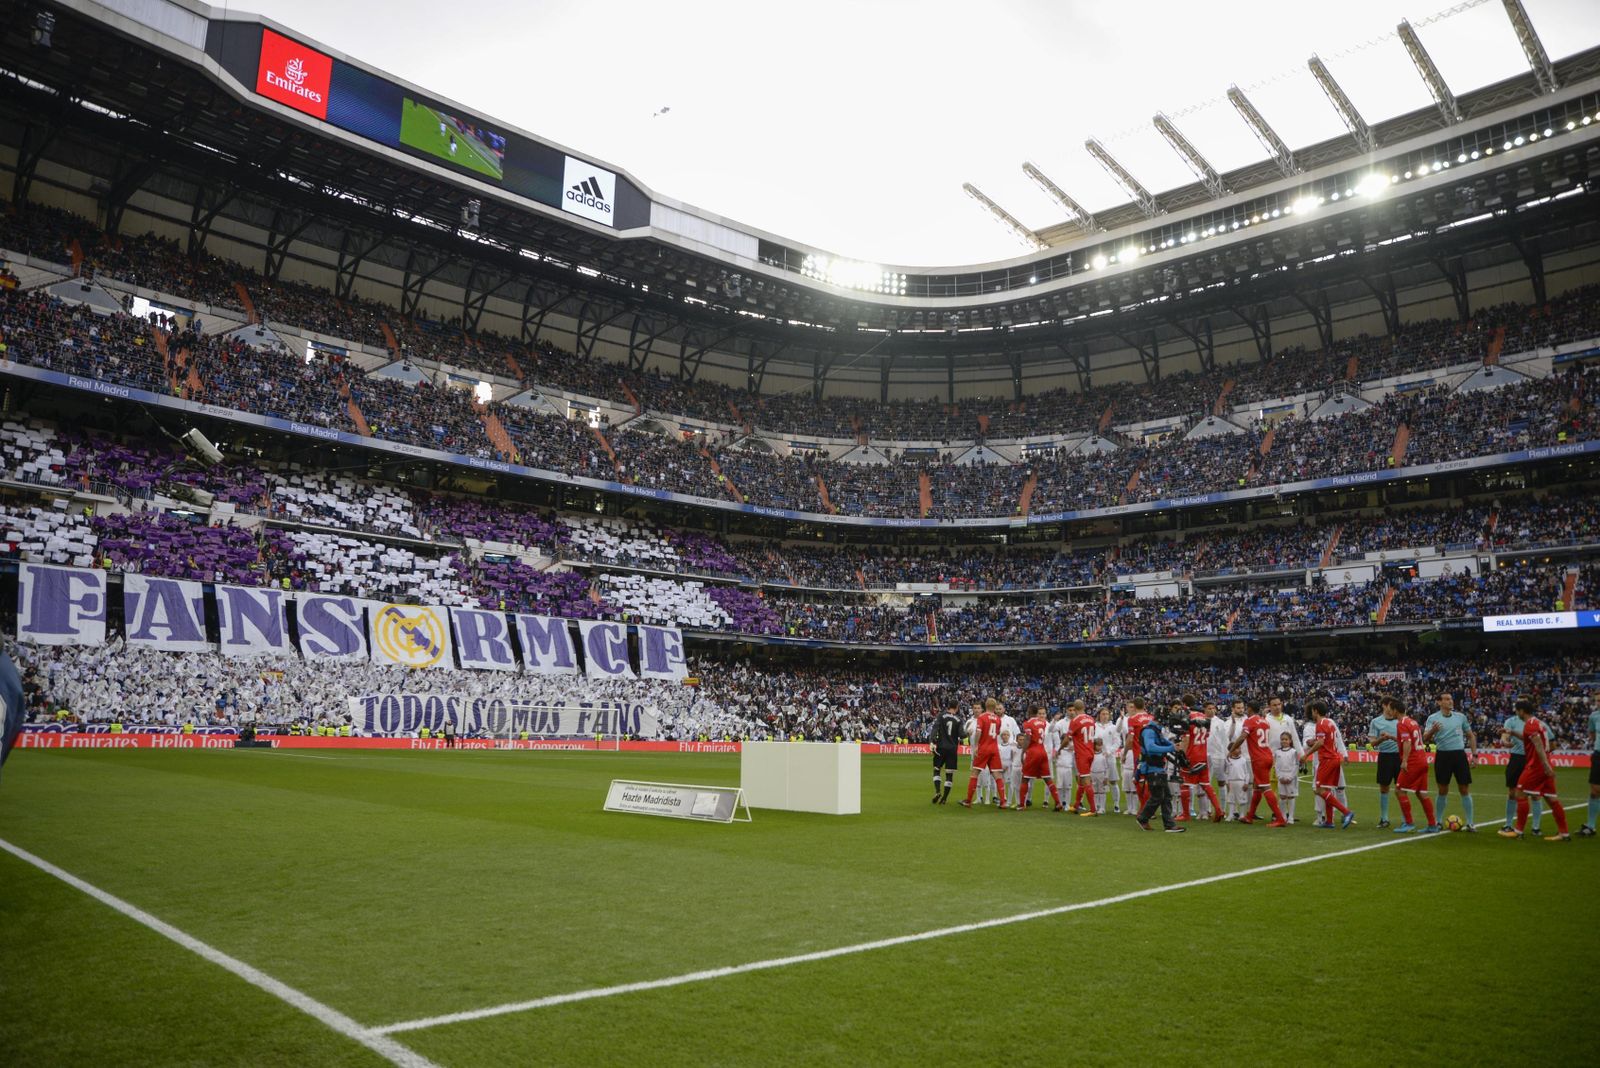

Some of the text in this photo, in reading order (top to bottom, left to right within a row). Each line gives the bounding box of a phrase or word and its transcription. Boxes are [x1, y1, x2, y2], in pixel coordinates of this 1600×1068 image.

[266, 69, 322, 103] Emirates
[566, 190, 611, 213] adidas
[68, 376, 129, 397] Real Madrid
[290, 423, 339, 440] Real Madrid
[1529, 442, 1585, 459] Real Madrid
[469, 457, 510, 472] Real Madrid
[1332, 472, 1377, 486] Real Madrid
[635, 487, 657, 497] Madrid
[1185, 495, 1209, 504] Madrid
[766, 508, 785, 517] Madrid
[900, 519, 921, 527] Madrid
[22, 566, 686, 675] FANS RMCF
[1496, 619, 1514, 627] REAL
[1515, 618, 1544, 626] MADRID
[360, 695, 645, 735] TODOS SOMOS FANS
[946, 721, 953, 736] 1
[988, 723, 997, 739] 4
[1193, 726, 1207, 745] 22
[21, 733, 139, 748] Fly Emirates
[151, 734, 194, 748] Hello
[411, 738, 431, 749] Fly
[679, 741, 737, 753] Fly Emirates
[622, 792, 682, 807] Hazte Madridista
